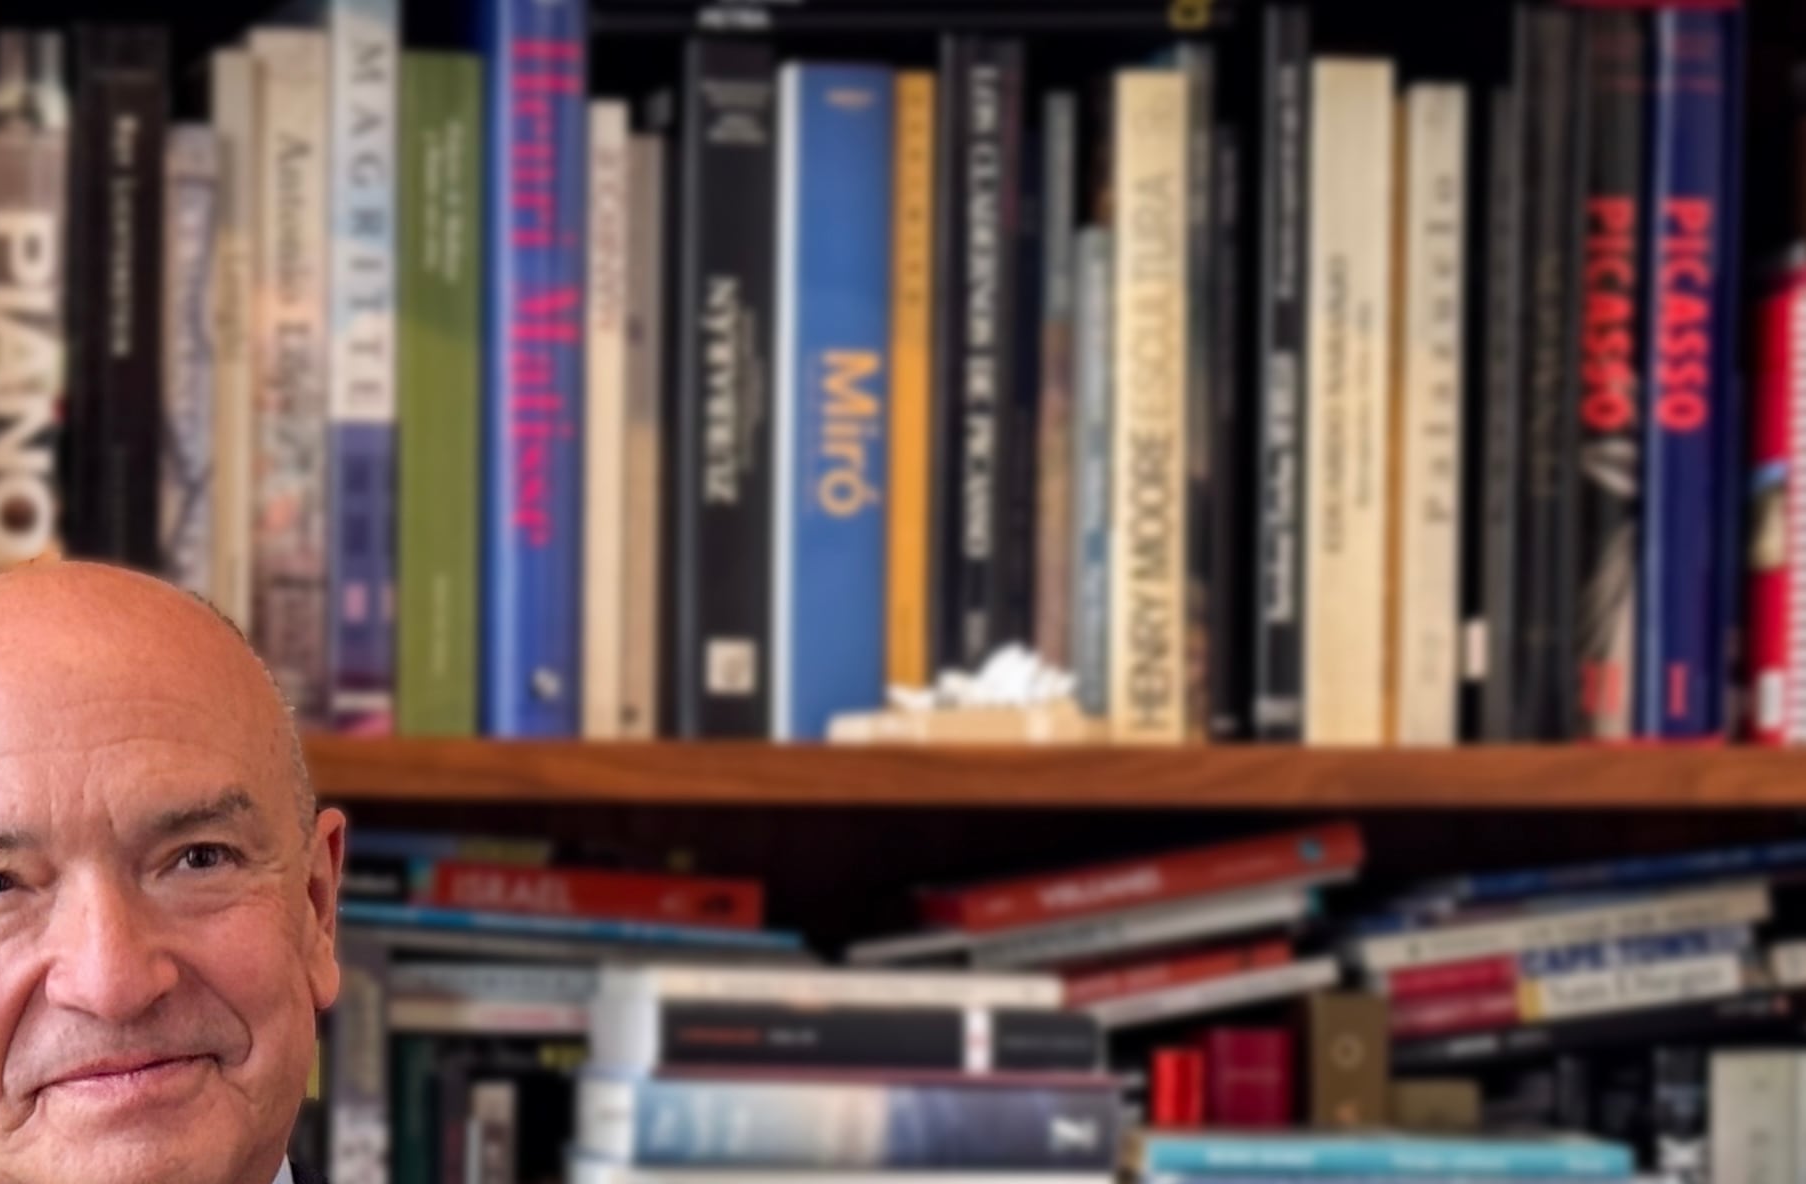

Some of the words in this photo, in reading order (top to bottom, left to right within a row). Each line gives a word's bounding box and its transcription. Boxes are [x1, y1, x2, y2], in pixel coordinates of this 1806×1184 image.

[275, 133, 317, 305] Antonio
[348, 40, 386, 405] MAGRITTE
[511, 38, 582, 248] Henri
[1128, 171, 1173, 421] ESCULTURA
[1423, 173, 1455, 522] Palazuelo
[1583, 195, 1637, 431] PICASSO
[1657, 195, 1714, 431] PICASSO
[511, 287, 582, 548] Matisse
[818, 350, 882, 518] Miró
[1128, 430, 1173, 583] MOORE
[1128, 592, 1173, 732] HENRY
[450, 872, 574, 913] ISRAEL
[1521, 940, 1612, 980] CAPE
